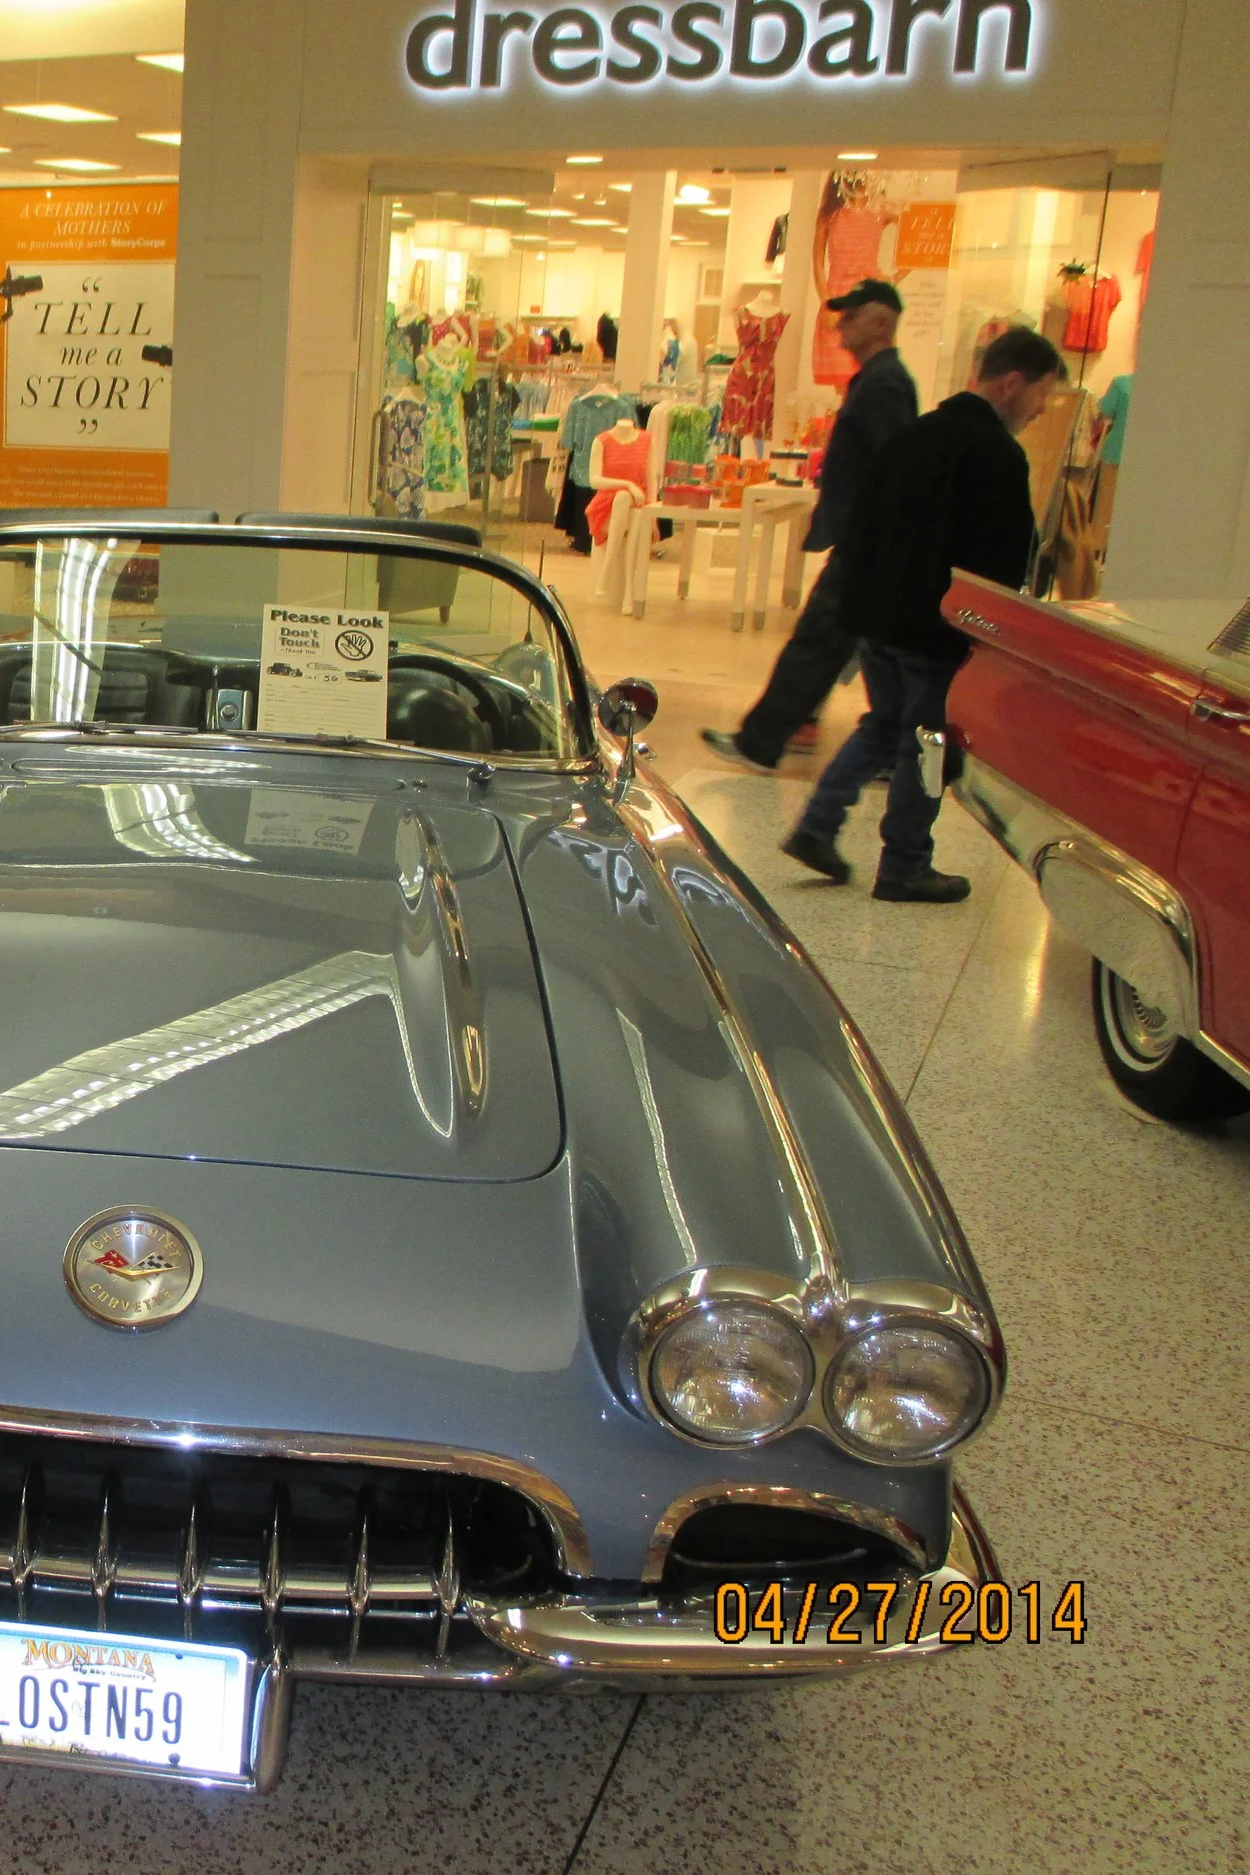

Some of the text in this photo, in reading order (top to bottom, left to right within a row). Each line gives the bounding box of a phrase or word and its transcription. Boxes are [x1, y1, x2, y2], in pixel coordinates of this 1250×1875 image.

[405, 0, 1032, 89] dressbarn
[20, 201, 167, 218] A CELEBRATION OF
[54, 220, 132, 236] MOTHERS
[29, 239, 84, 251] partnership
[87, 238, 107, 248] with
[34, 301, 152, 336] TELL
[61, 346, 123, 366] me a
[20, 374, 164, 410] STORY
[270, 609, 383, 629] Please Look
[279, 637, 320, 649] Touch
[280, 627, 319, 639] Don't
[91, 1223, 182, 1258] CHEVROLET
[21, 1638, 156, 1676] MONTANA
[109, 1671, 147, 1681] Country
